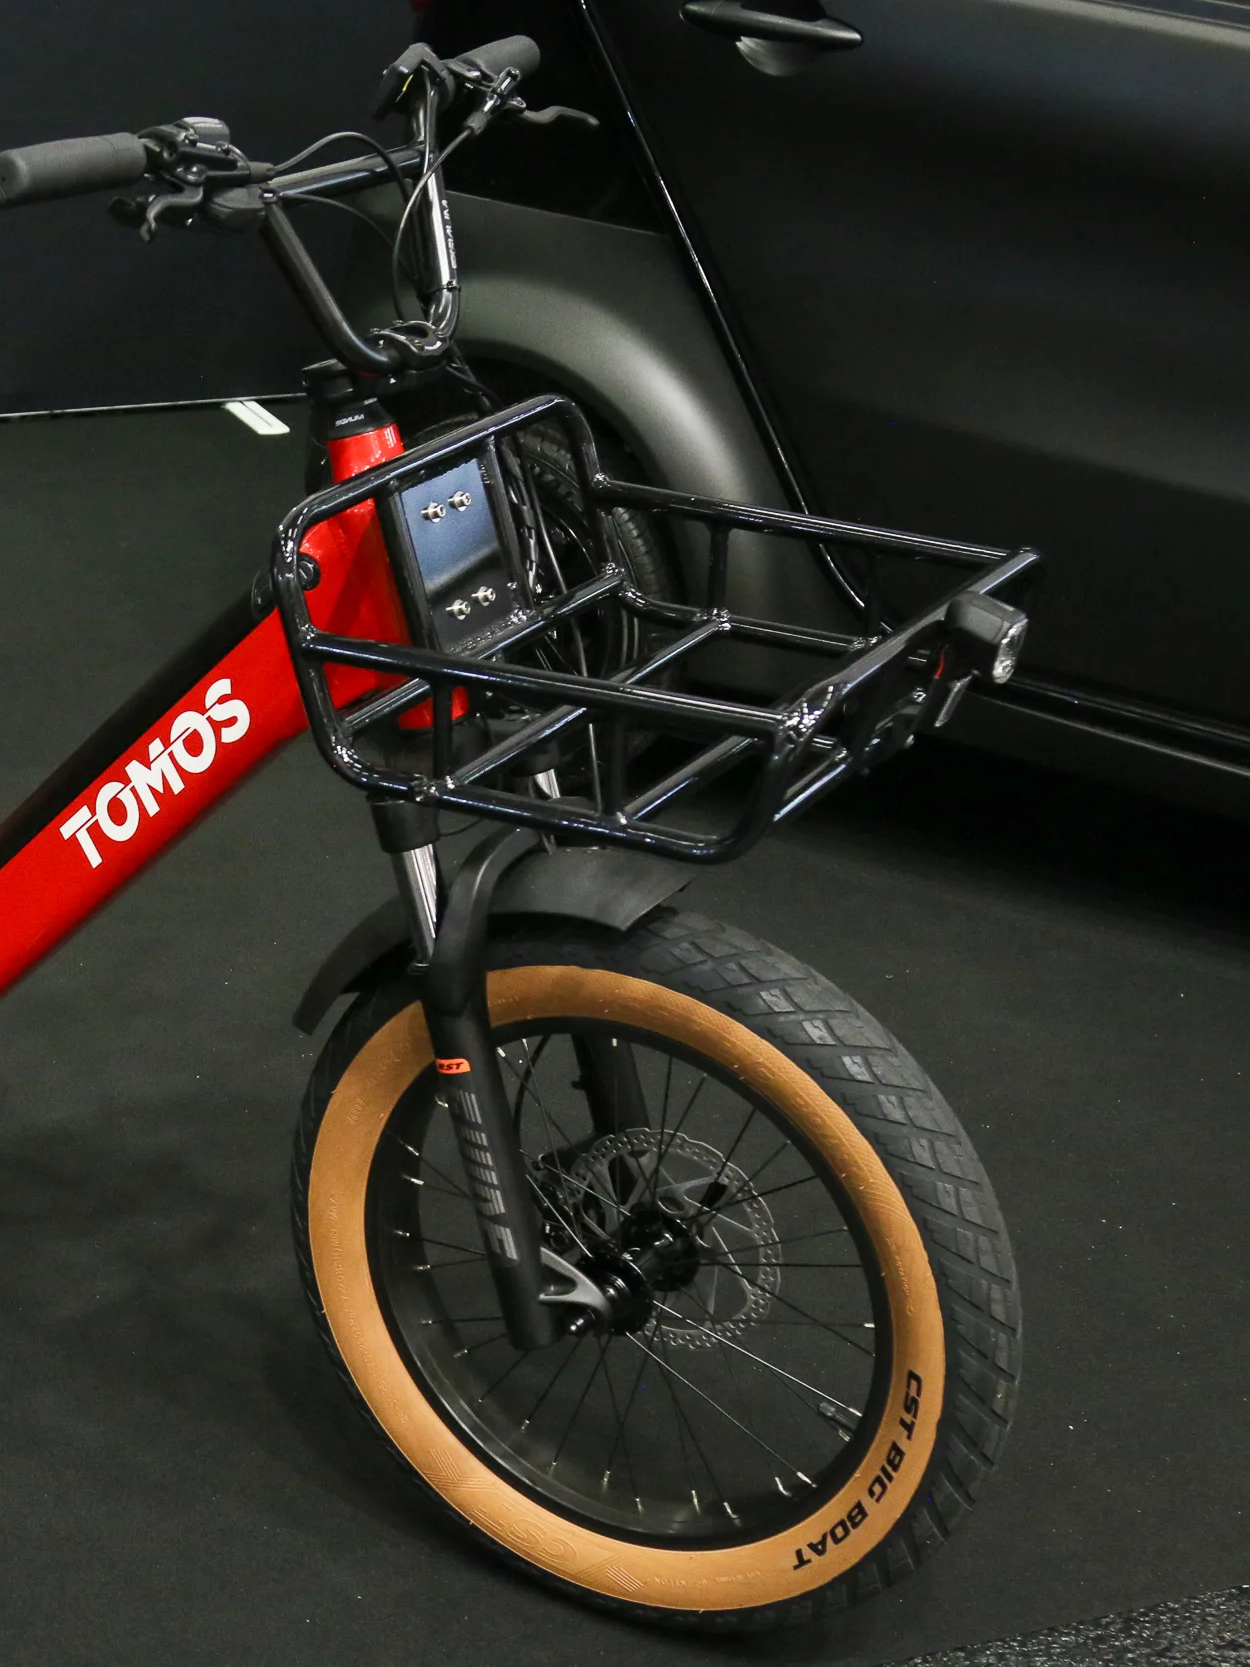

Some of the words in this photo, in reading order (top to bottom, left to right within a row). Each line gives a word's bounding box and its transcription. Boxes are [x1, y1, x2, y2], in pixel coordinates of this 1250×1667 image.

[59, 678, 251, 869] TOMOS
[899, 1369, 923, 1441] CST
[867, 1440, 906, 1504] BIG
[793, 1499, 869, 1571] BOAT
